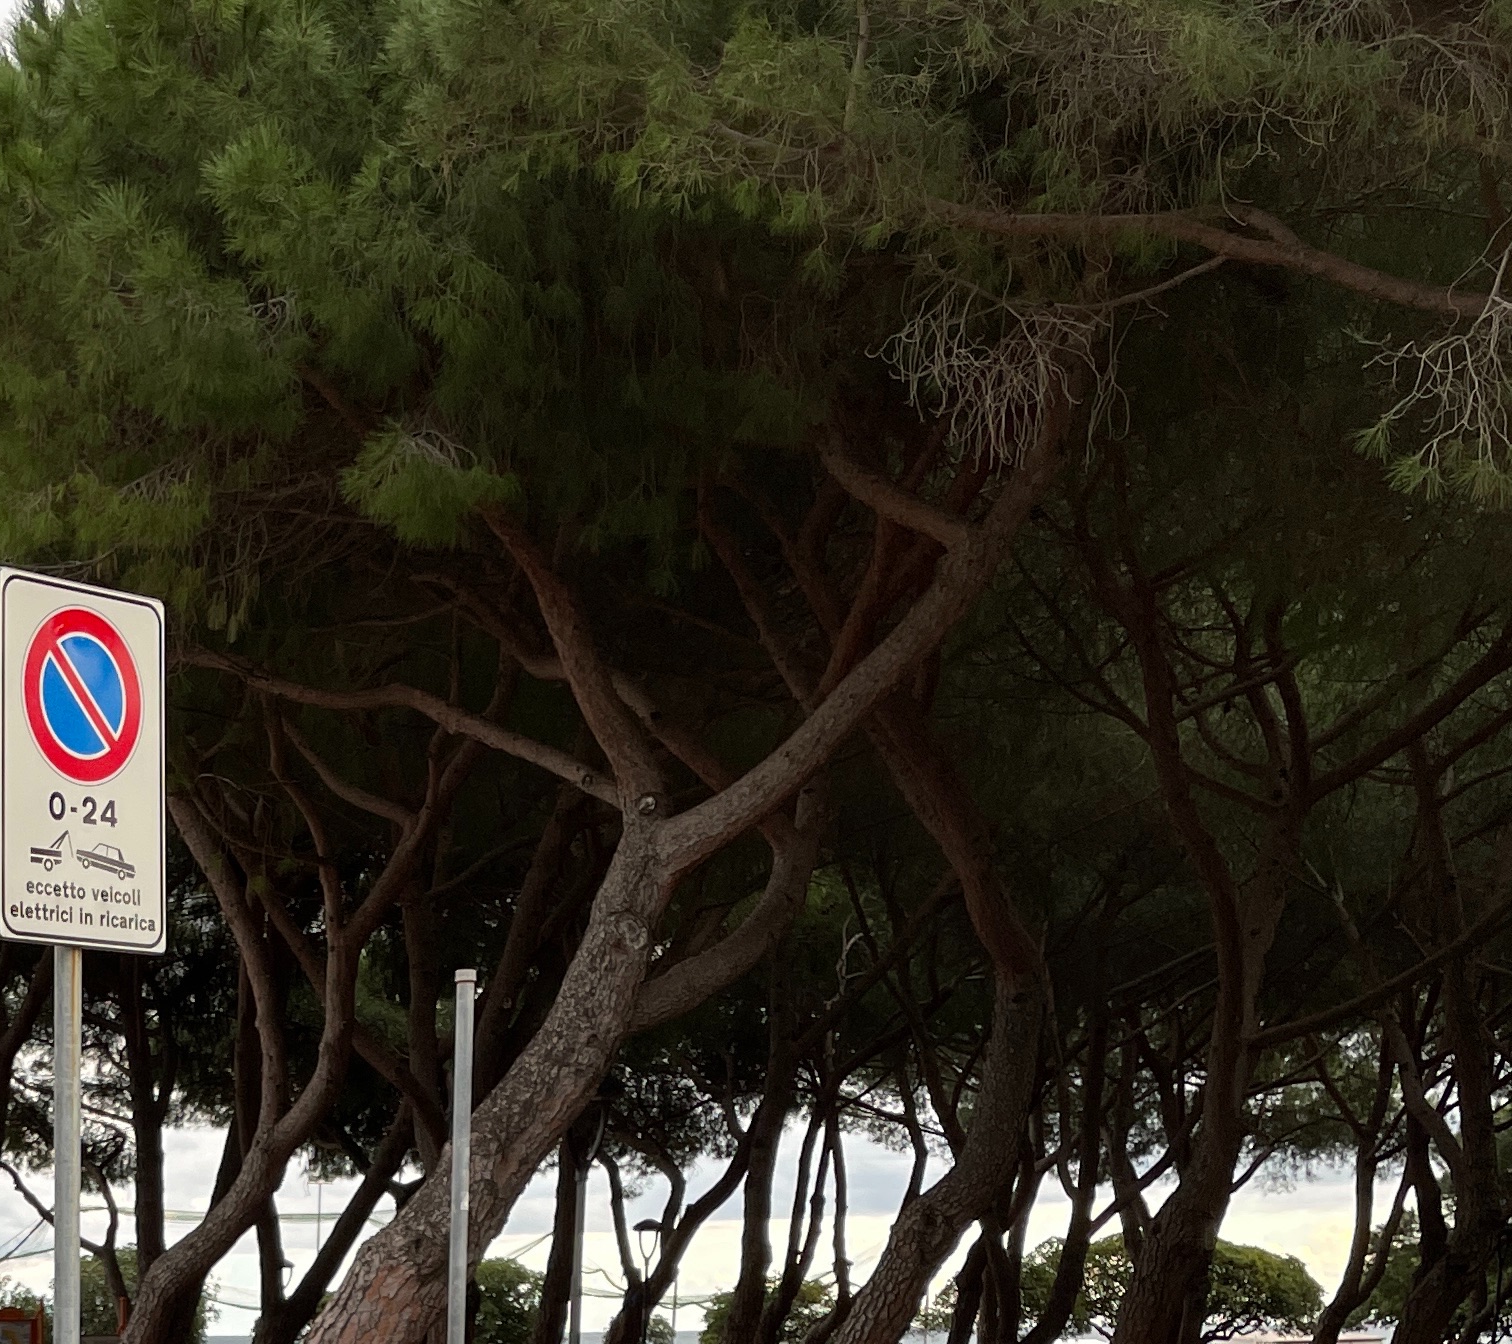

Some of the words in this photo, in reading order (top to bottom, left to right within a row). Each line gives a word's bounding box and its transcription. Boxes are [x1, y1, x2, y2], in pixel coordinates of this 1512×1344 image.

[49, 791, 117, 828] 0-24
[26, 880, 86, 900] eccetto
[92, 886, 141, 906] veicoli
[10, 901, 73, 924] elettrici
[79, 907, 94, 925] in
[100, 910, 156, 932] ricarica
